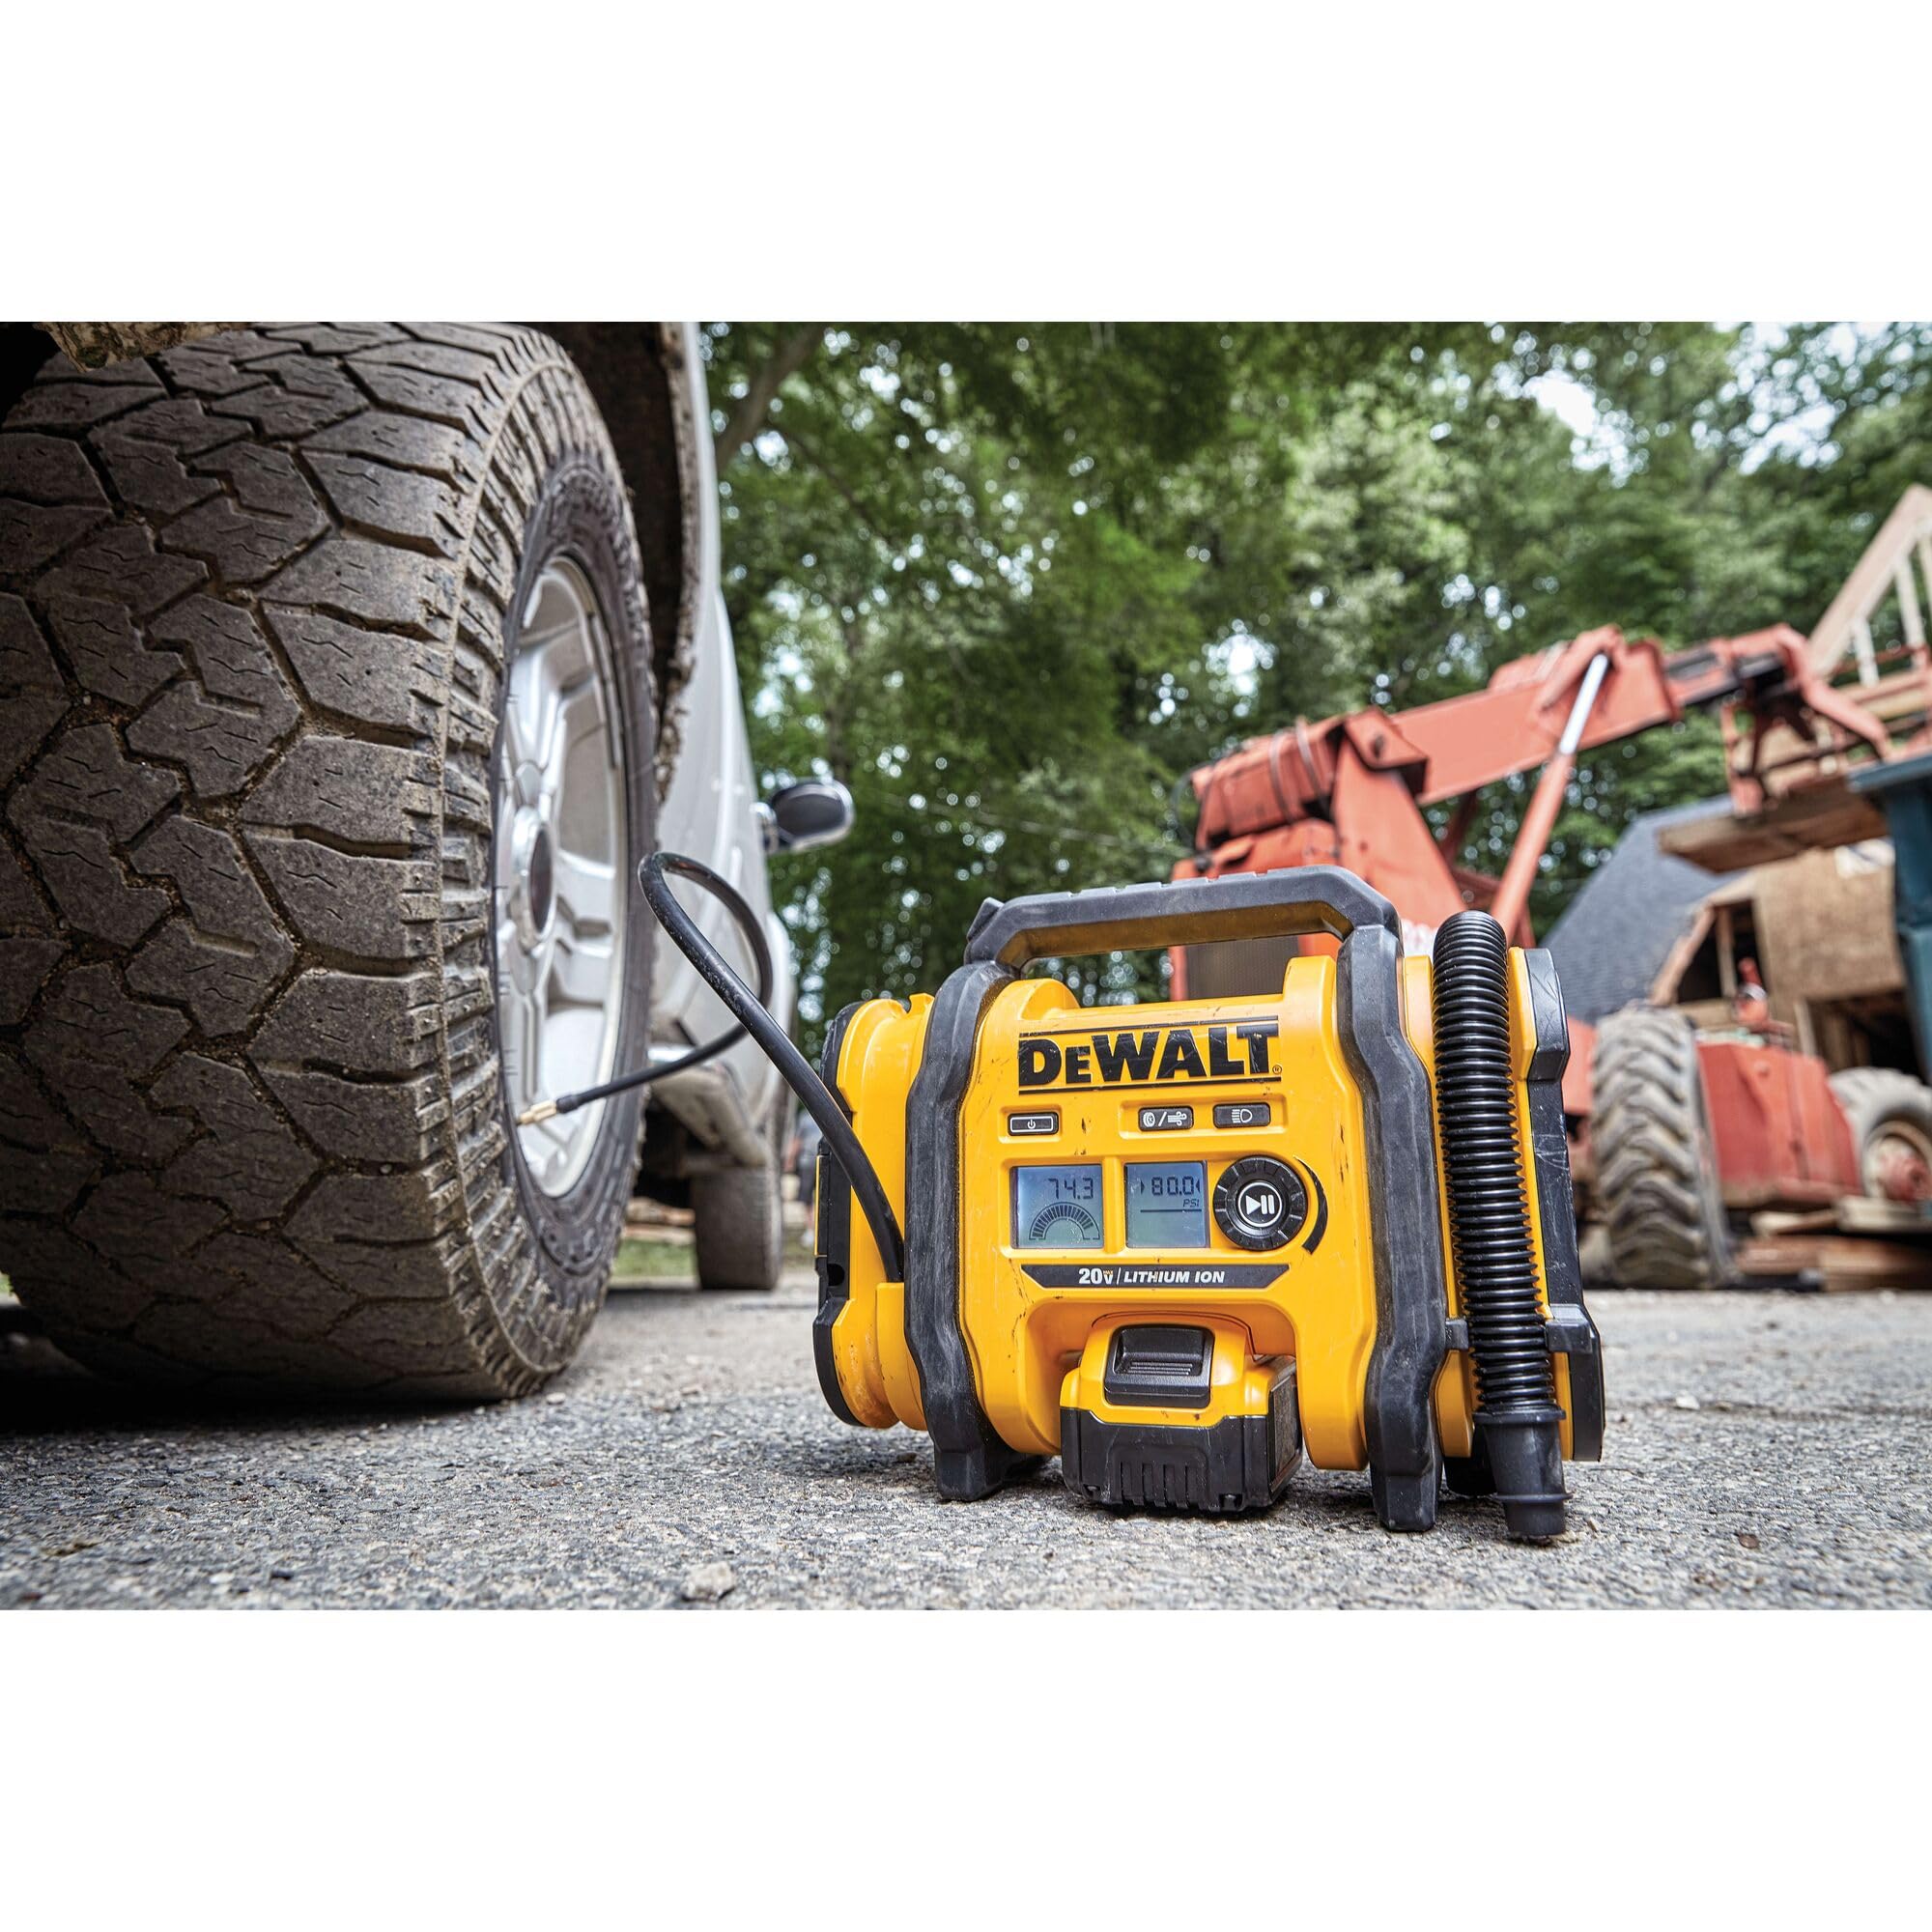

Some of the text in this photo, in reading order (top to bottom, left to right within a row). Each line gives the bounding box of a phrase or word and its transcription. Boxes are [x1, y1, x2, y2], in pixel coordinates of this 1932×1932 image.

[1047, 1178, 1094, 1200] 74.3
[1151, 1176, 1195, 1196] 80.0
[1182, 1199, 1200, 1208] PSI
[1123, 1270, 1190, 1283] LITHIUM
[1194, 1270, 1226, 1283] ION
